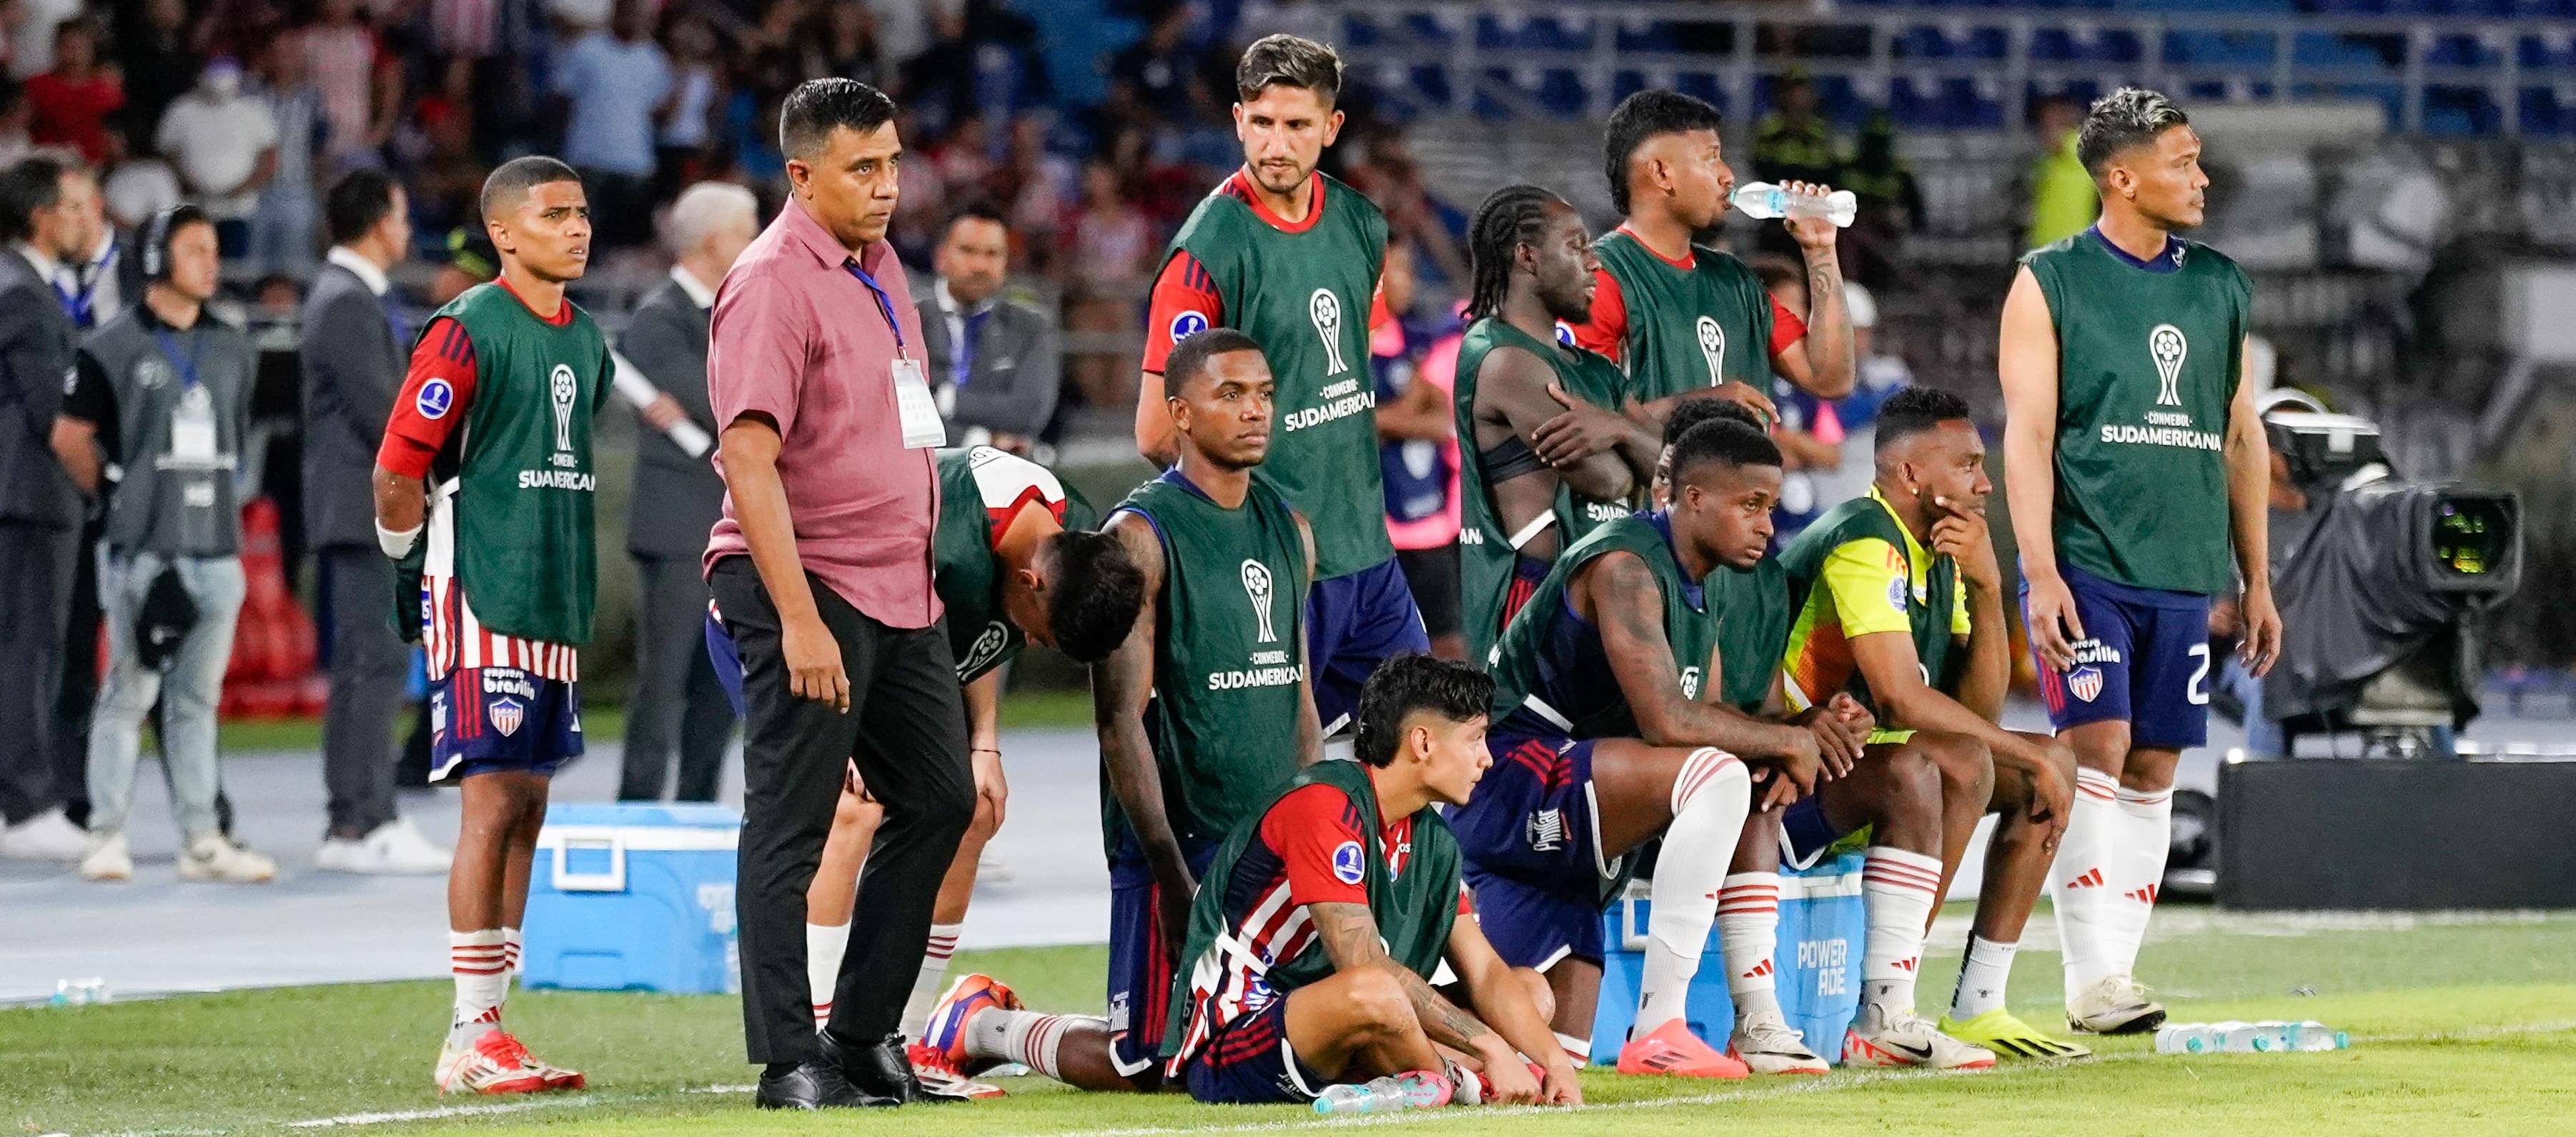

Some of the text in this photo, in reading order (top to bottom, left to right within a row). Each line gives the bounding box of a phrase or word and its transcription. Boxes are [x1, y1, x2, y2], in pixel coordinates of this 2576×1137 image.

[2101, 424, 2222, 452] SUDAMERICANA
[1797, 938, 1847, 970] POWER
[1818, 967, 1846, 997] ADE
